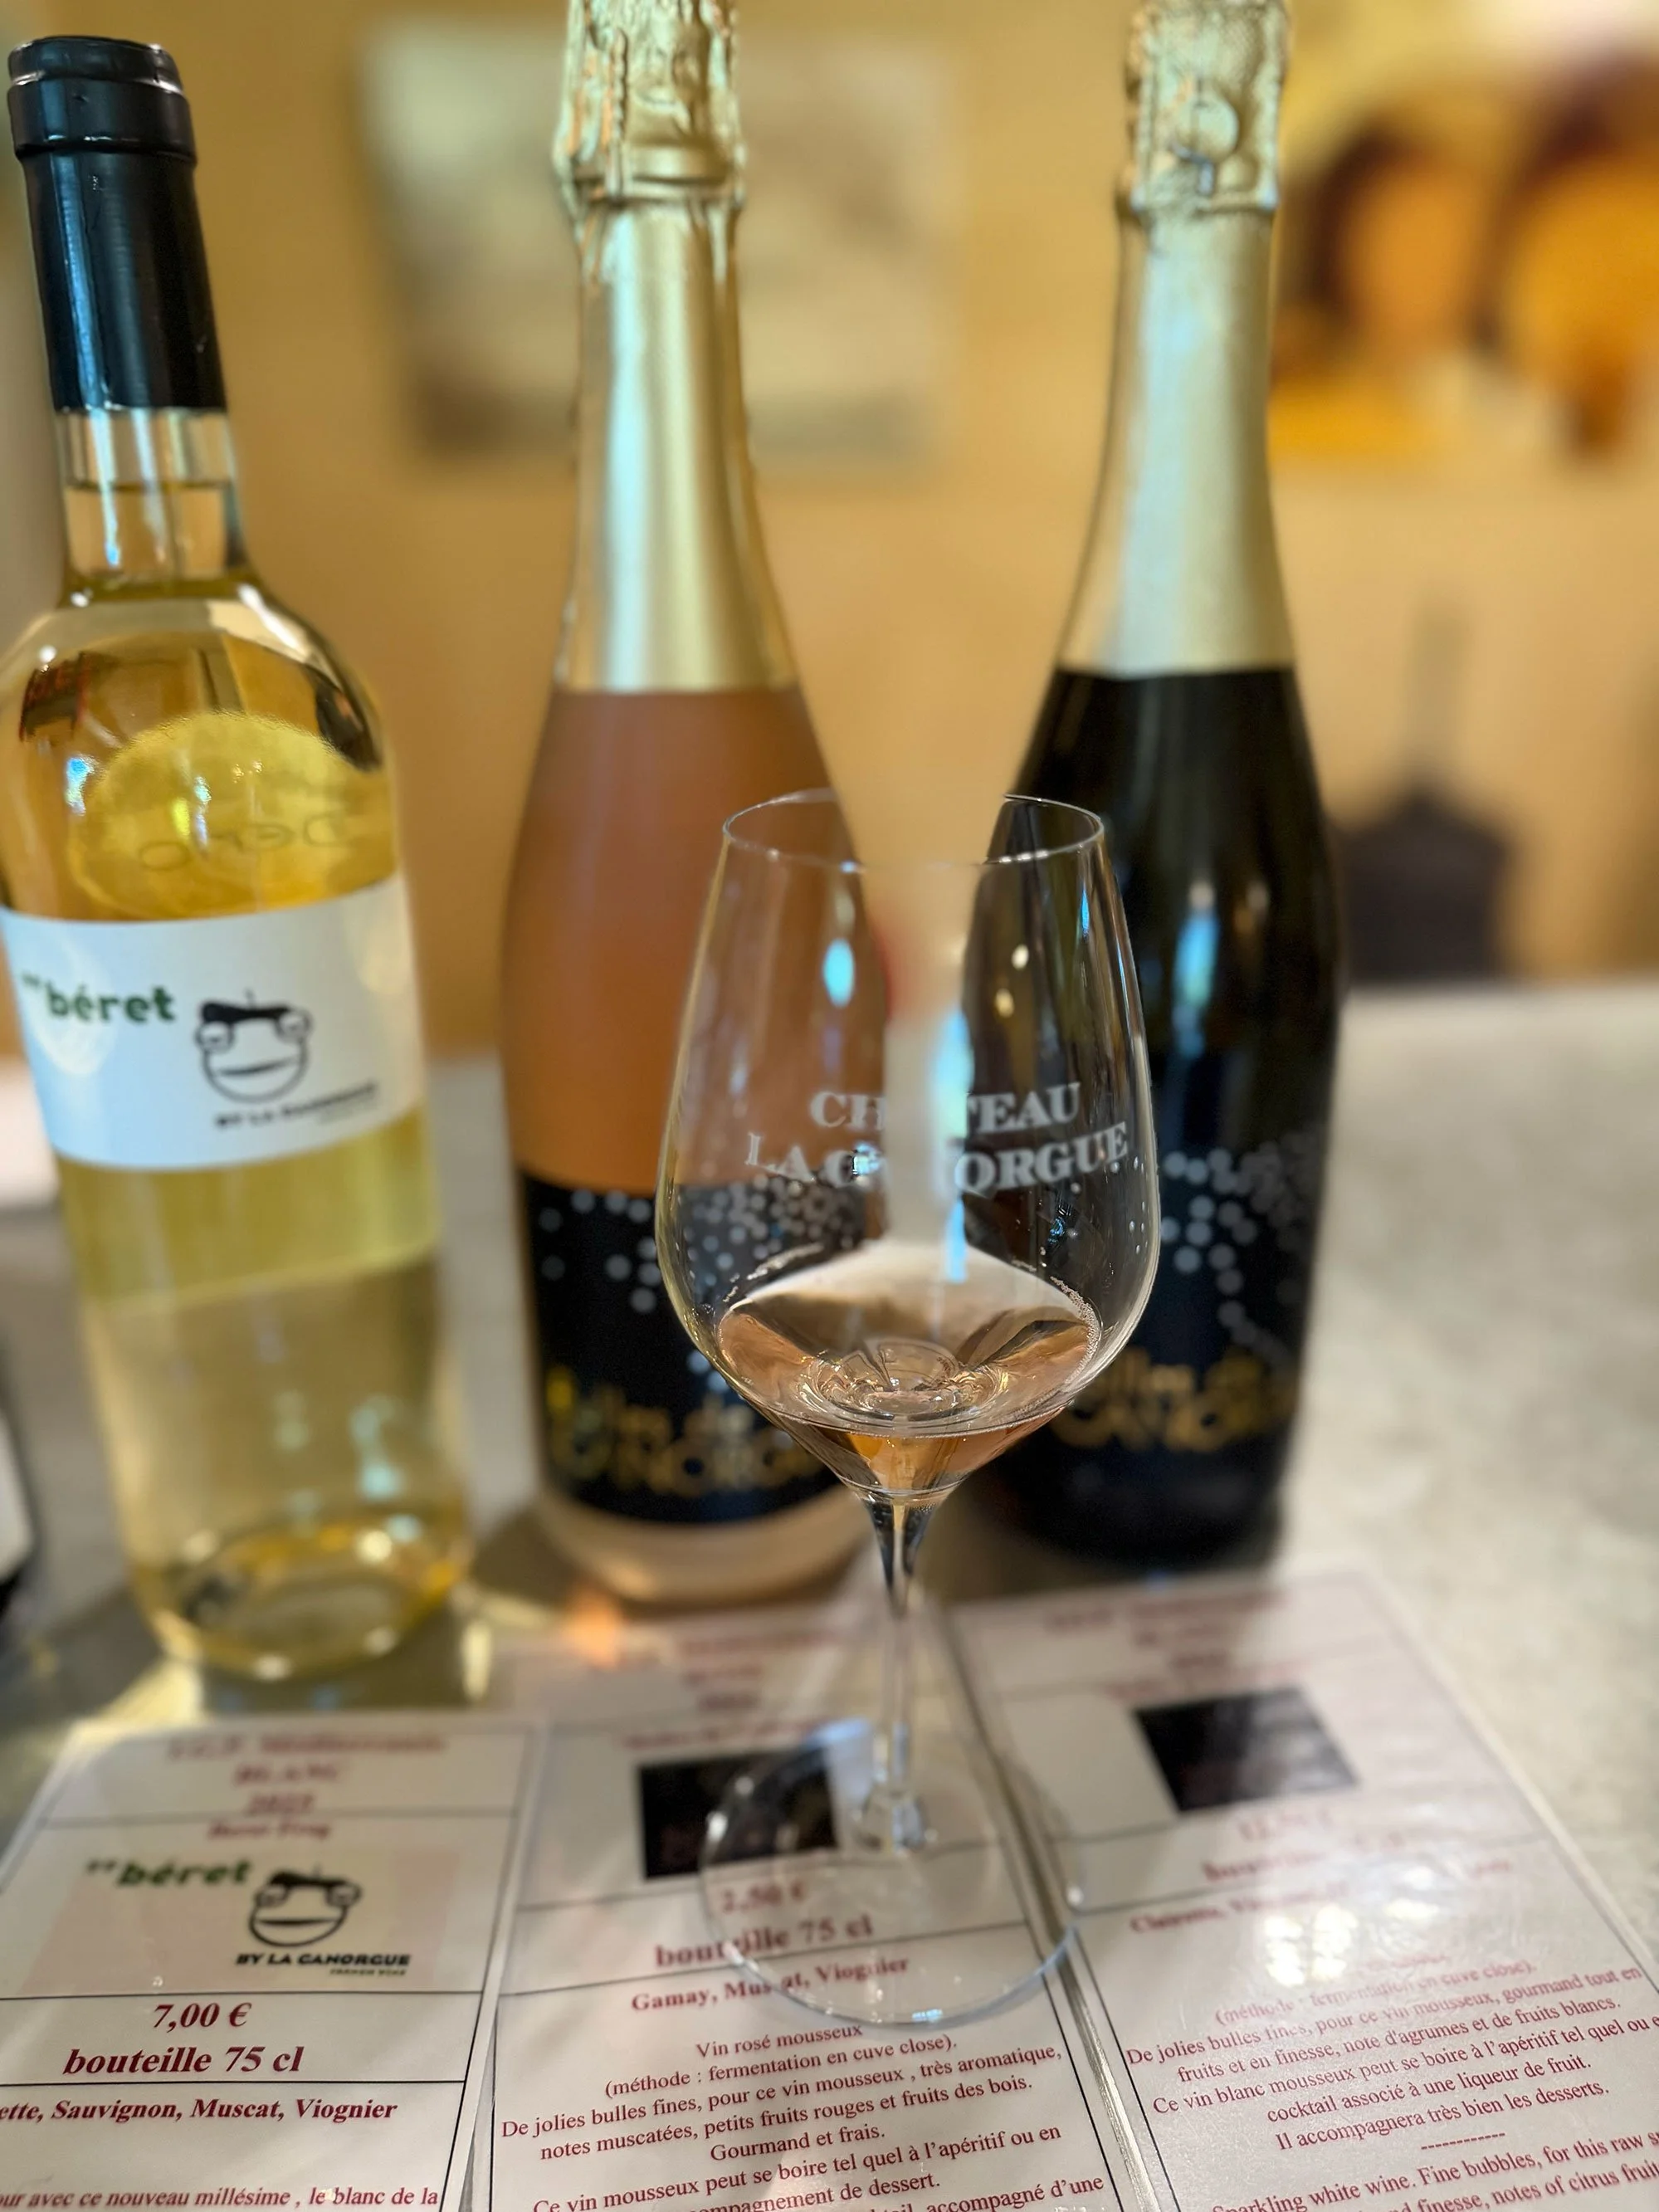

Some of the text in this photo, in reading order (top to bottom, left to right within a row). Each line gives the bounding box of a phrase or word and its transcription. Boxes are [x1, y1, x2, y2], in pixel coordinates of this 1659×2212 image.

[46, 980, 175, 1023] béret
[809, 1082, 1081, 1132] CHEAU
[744, 1132, 815, 1183] LA
[117, 1860, 251, 1887] béret
[798, 1917, 837, 1943] 75
[845, 1913, 874, 1938] cl
[237, 1953, 411, 1965] BY LA CANORGUE
[154, 2003, 220, 2034] 7,00
[631, 1990, 718, 2011] Gamay,
[1126, 2048, 1153, 2064] De
[1156, 2039, 1206, 2066] jolies
[1208, 2031, 1261, 2050] bulles
[1315, 2015, 1354, 2037] pour
[1359, 2013, 1378, 2024] ce
[1383, 2005, 1410, 2020] vin
[1413, 1993, 1500, 2016] mousseux,
[1501, 1974, 1584, 2004] gourmand
[1583, 1970, 1620, 1987] tout
[1622, 1966, 1642, 1980] en
[62, 2046, 305, 2075] bouteille 75 cl
[695, 2025, 862, 2058] Vin rosé mousseux
[1176, 1998, 1621, 2083] fruits et en finesse, note d'agrumes et de fruits blancs.
[605, 2071, 691, 2100] (méthode
[708, 2054, 822, 2082] fermentation
[827, 2052, 848, 2065] en
[852, 2046, 895, 2062] cuve
[900, 2034, 957, 2054] close).
[1153, 2097, 1179, 2114] Ce
[1183, 2091, 1214, 2109] vin
[1214, 2084, 1266, 2103] blanc
[1267, 2068, 1358, 2094] mousseux
[1358, 2058, 1399, 2082] peut
[1400, 2057, 1421, 2071] se
[1420, 2047, 1469, 2067] boire
[1470, 2044, 1485, 2059] à
[1560, 2025, 1585, 2045] tel
[1587, 2019, 1625, 2043] quel
[1627, 2019, 1651, 2032] ou
[1267, 2053, 1592, 2122] cocktail associé à une liqueur de fruit.
[51, 2099, 183, 2123] Sauvignon,
[189, 2098, 285, 2122] Muscat,
[296, 2098, 398, 2124] Viognier
[501, 2121, 529, 2137] De
[532, 2113, 586, 2139] jolies
[591, 2104, 647, 2126] bulles
[651, 2098, 702, 2117] fines,
[708, 2091, 750, 2112] pour
[755, 2087, 776, 2101] ce
[782, 2079, 811, 2097] vin
[816, 2069, 905, 2092] mousseux
[920, 2060, 953, 2078] très
[957, 2047, 1061, 2073] aromatique,
[540, 2074, 1032, 2161] notes muscatées, petits fruits rouges et fruits des bois.
[1275, 2082, 1609, 2151] Il accompagnera très bien les desserts.
[710, 2123, 885, 2161] Gourmand et frais.
[566, 2194, 598, 2212] vin
[603, 2180, 700, 2208] mousseux
[705, 2170, 748, 2196] peut
[752, 2170, 773, 2185] se
[777, 2160, 828, 2180] boire
[832, 2152, 857, 2172] tel
[862, 2146, 904, 2172] quel
[908, 2145, 920, 2162] à
[924, 2130, 1006, 2161] l’apéritif
[1010, 2131, 1035, 2146] ou
[1038, 2127, 1061, 2141] en
[840, 2182, 863, 2201] de
[868, 2173, 940, 2197] dessert.
[1050, 2177, 1104, 2198] d’une
[1308, 2183, 1361, 2205] white
[1364, 2175, 1416, 2195] wine.
[1417, 2166, 1461, 2186] Fine
[1461, 2151, 1543, 2177] bubbles,
[1543, 2146, 1571, 2165] for
[1573, 2138, 1608, 2159] this
[1610, 2134, 1644, 2153] raw
[27, 2194, 75, 2207] avec
[79, 2193, 103, 2207] ce
[105, 2192, 190, 2206] nouveau
[194, 2187, 291, 2206] millésime
[308, 2186, 326, 2205] le
[332, 2186, 386, 2205] blanc
[390, 2186, 415, 2205] de
[420, 2186, 438, 2205] la
[1417, 2195, 1491, 2212] finesse,
[1491, 2185, 1542, 2205] notes
[1544, 2175, 1565, 2195] of
[1568, 2171, 1620, 2192] citrus
